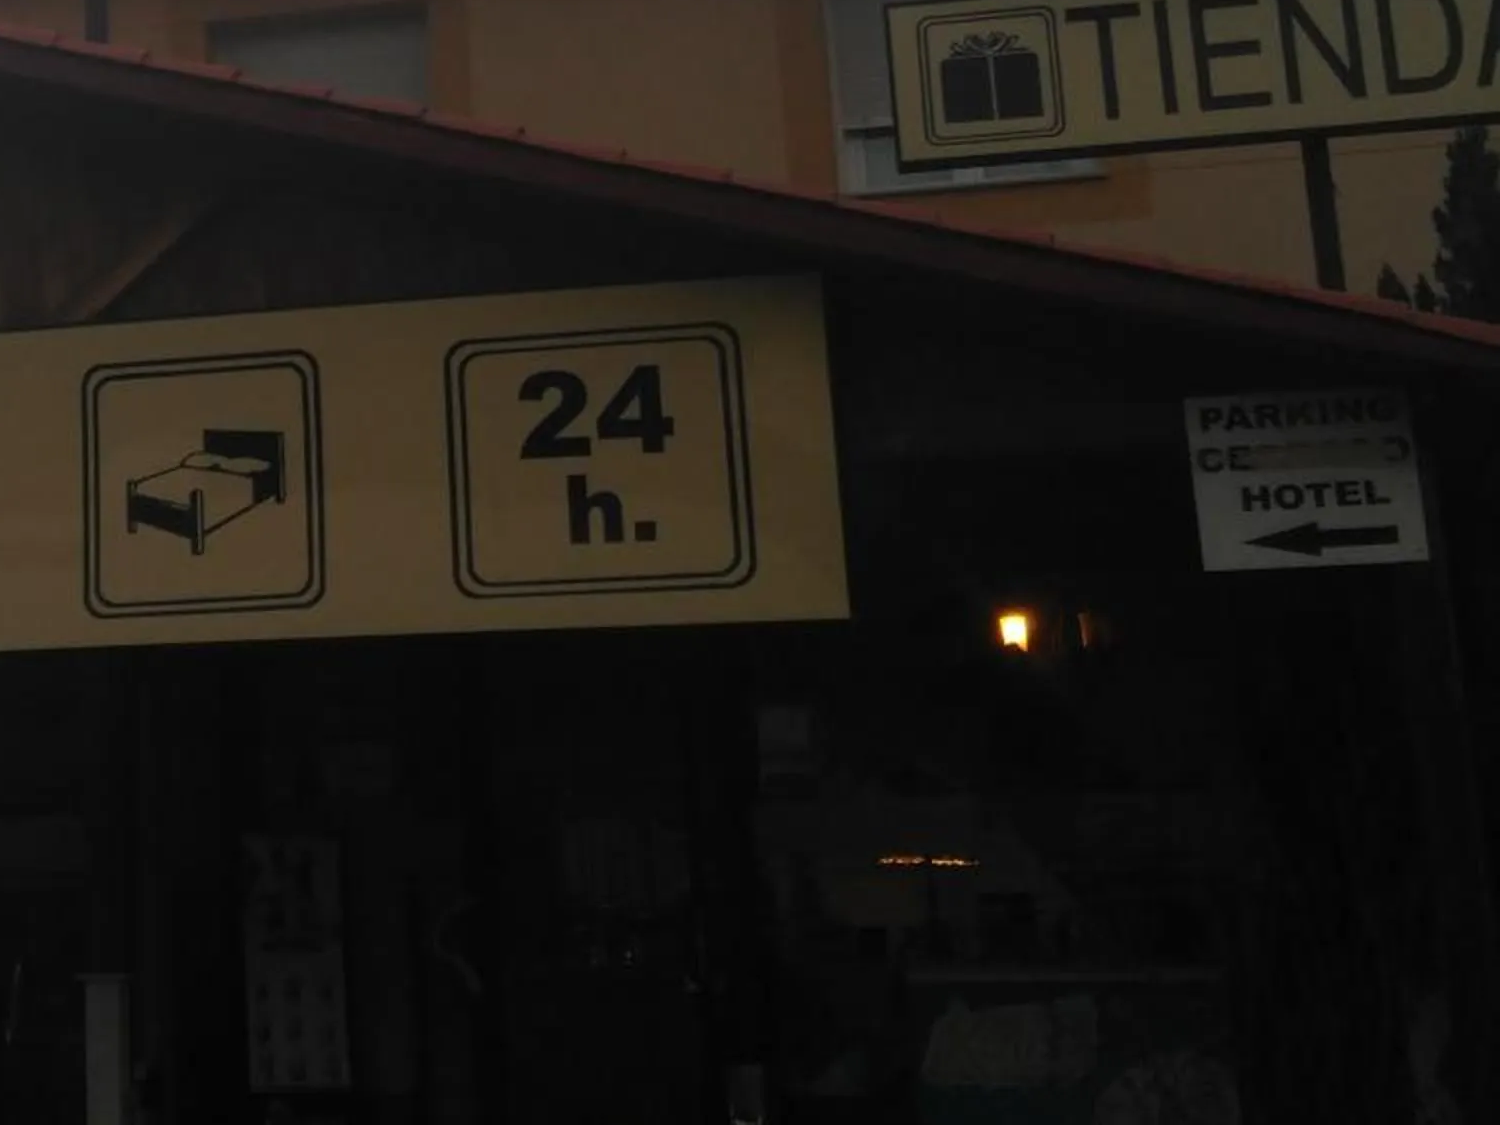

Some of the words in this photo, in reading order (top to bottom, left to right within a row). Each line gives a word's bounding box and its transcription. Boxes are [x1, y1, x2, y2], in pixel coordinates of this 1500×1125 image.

[518, 364, 674, 460] 24
[1200, 397, 1398, 434] PARKING
[566, 473, 657, 544] h.
[1241, 479, 1391, 512] HOTEL
